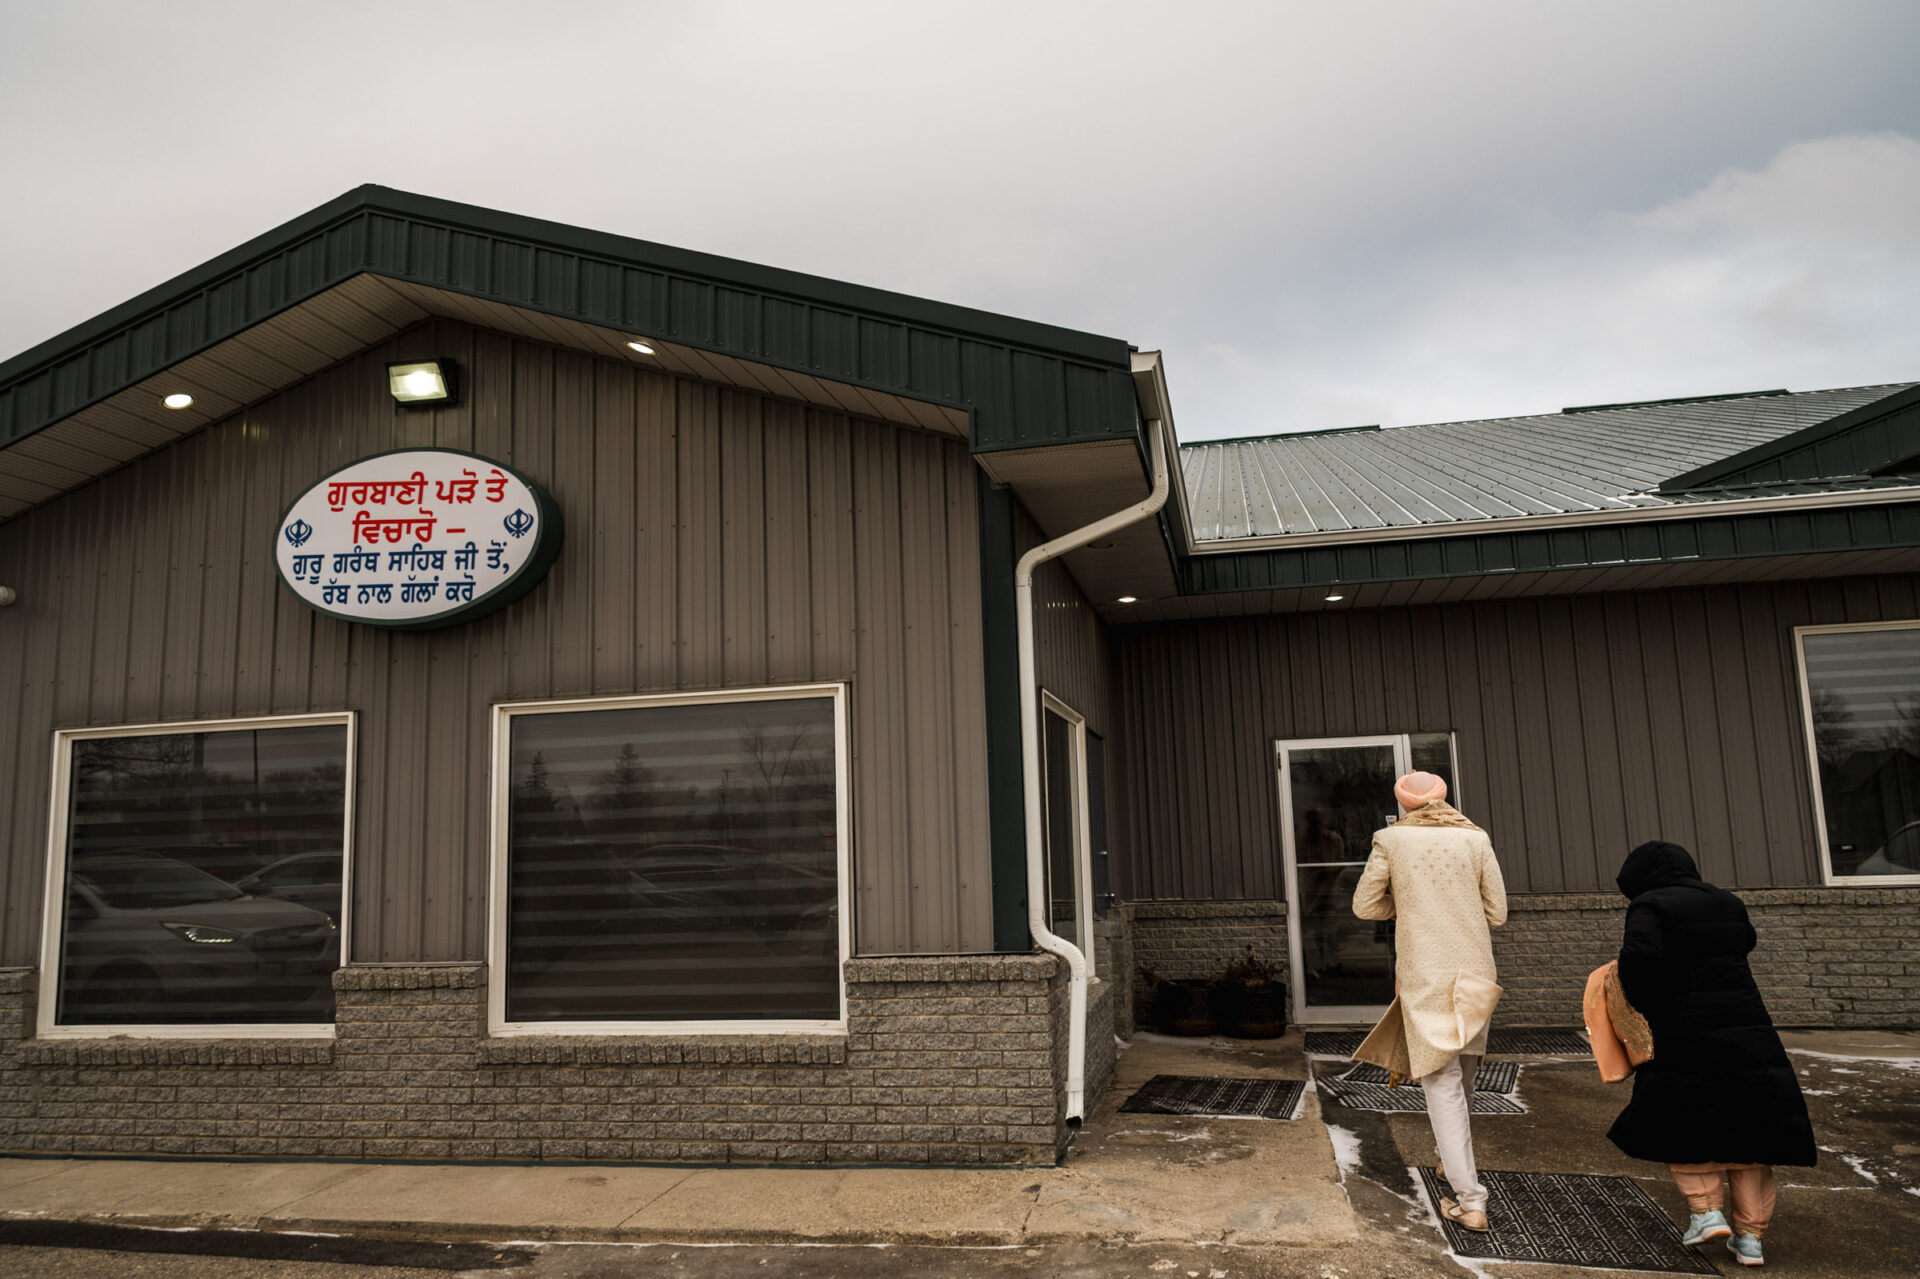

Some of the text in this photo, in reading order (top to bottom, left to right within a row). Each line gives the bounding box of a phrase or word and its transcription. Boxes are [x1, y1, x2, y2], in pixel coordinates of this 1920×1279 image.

[327, 471, 428, 512] ਗੁਰਬਾਣੀ
[485, 469, 508, 503] ਤੇ
[352, 507, 437, 544] ਵਿਚਾਰੋ
[292, 554, 325, 584] ਗੁਰੂ
[388, 543, 447, 571] ਸਾਹਿਬ
[455, 541, 479, 570] ਜੀ
[322, 573, 476, 605] ਰੱਬ ਨਾਲ ਗੱਲਾਂ ਕਰੋ
